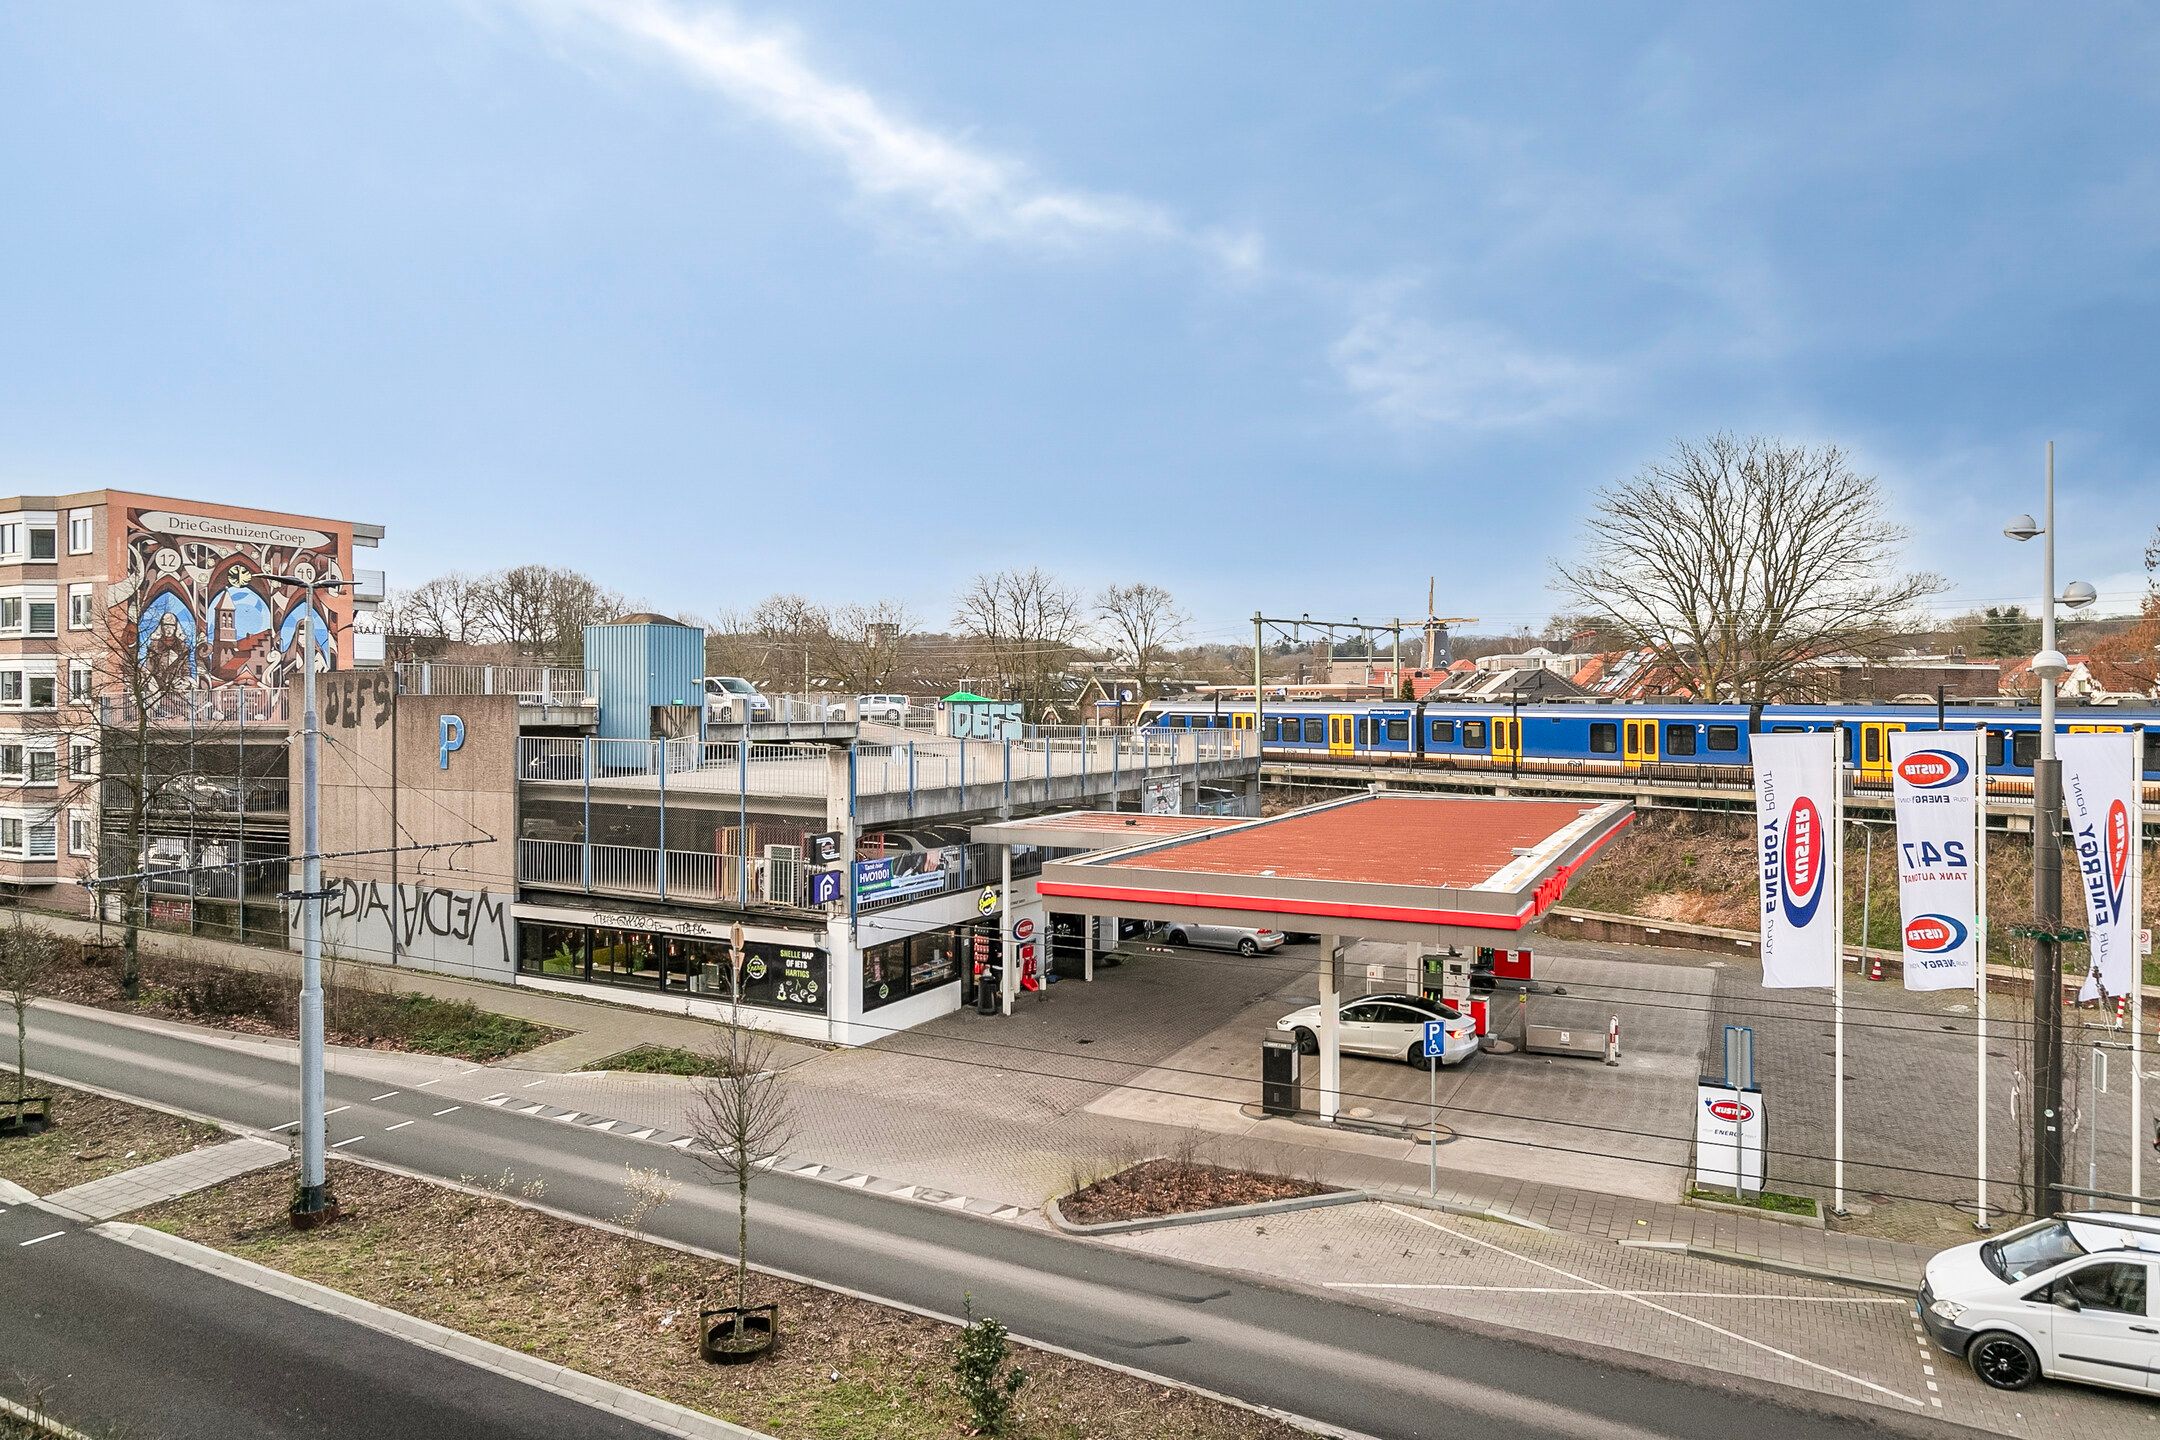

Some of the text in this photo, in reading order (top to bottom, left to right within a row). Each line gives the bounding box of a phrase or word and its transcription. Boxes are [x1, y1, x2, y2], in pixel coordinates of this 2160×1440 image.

[168, 516, 306, 545] Drie Gasthuizen Groep
[160, 554, 176, 568] 12
[297, 567, 312, 579] 46
[325, 673, 392, 730] DEFS
[953, 703, 1022, 740] DEFS
[1380, 718, 1387, 727] 2
[1455, 719, 1462, 728] 2
[1697, 724, 1705, 734] 2
[1807, 725, 1815, 734] 2
[2004, 729, 2014, 740] 2
[439, 714, 466, 770] P
[780, 949, 814, 960] SNELLE HAP
[785, 959, 808, 969] OF IETS
[1429, 1023, 1440, 1041] P
[1714, 1105, 1748, 1117] KUSTR
